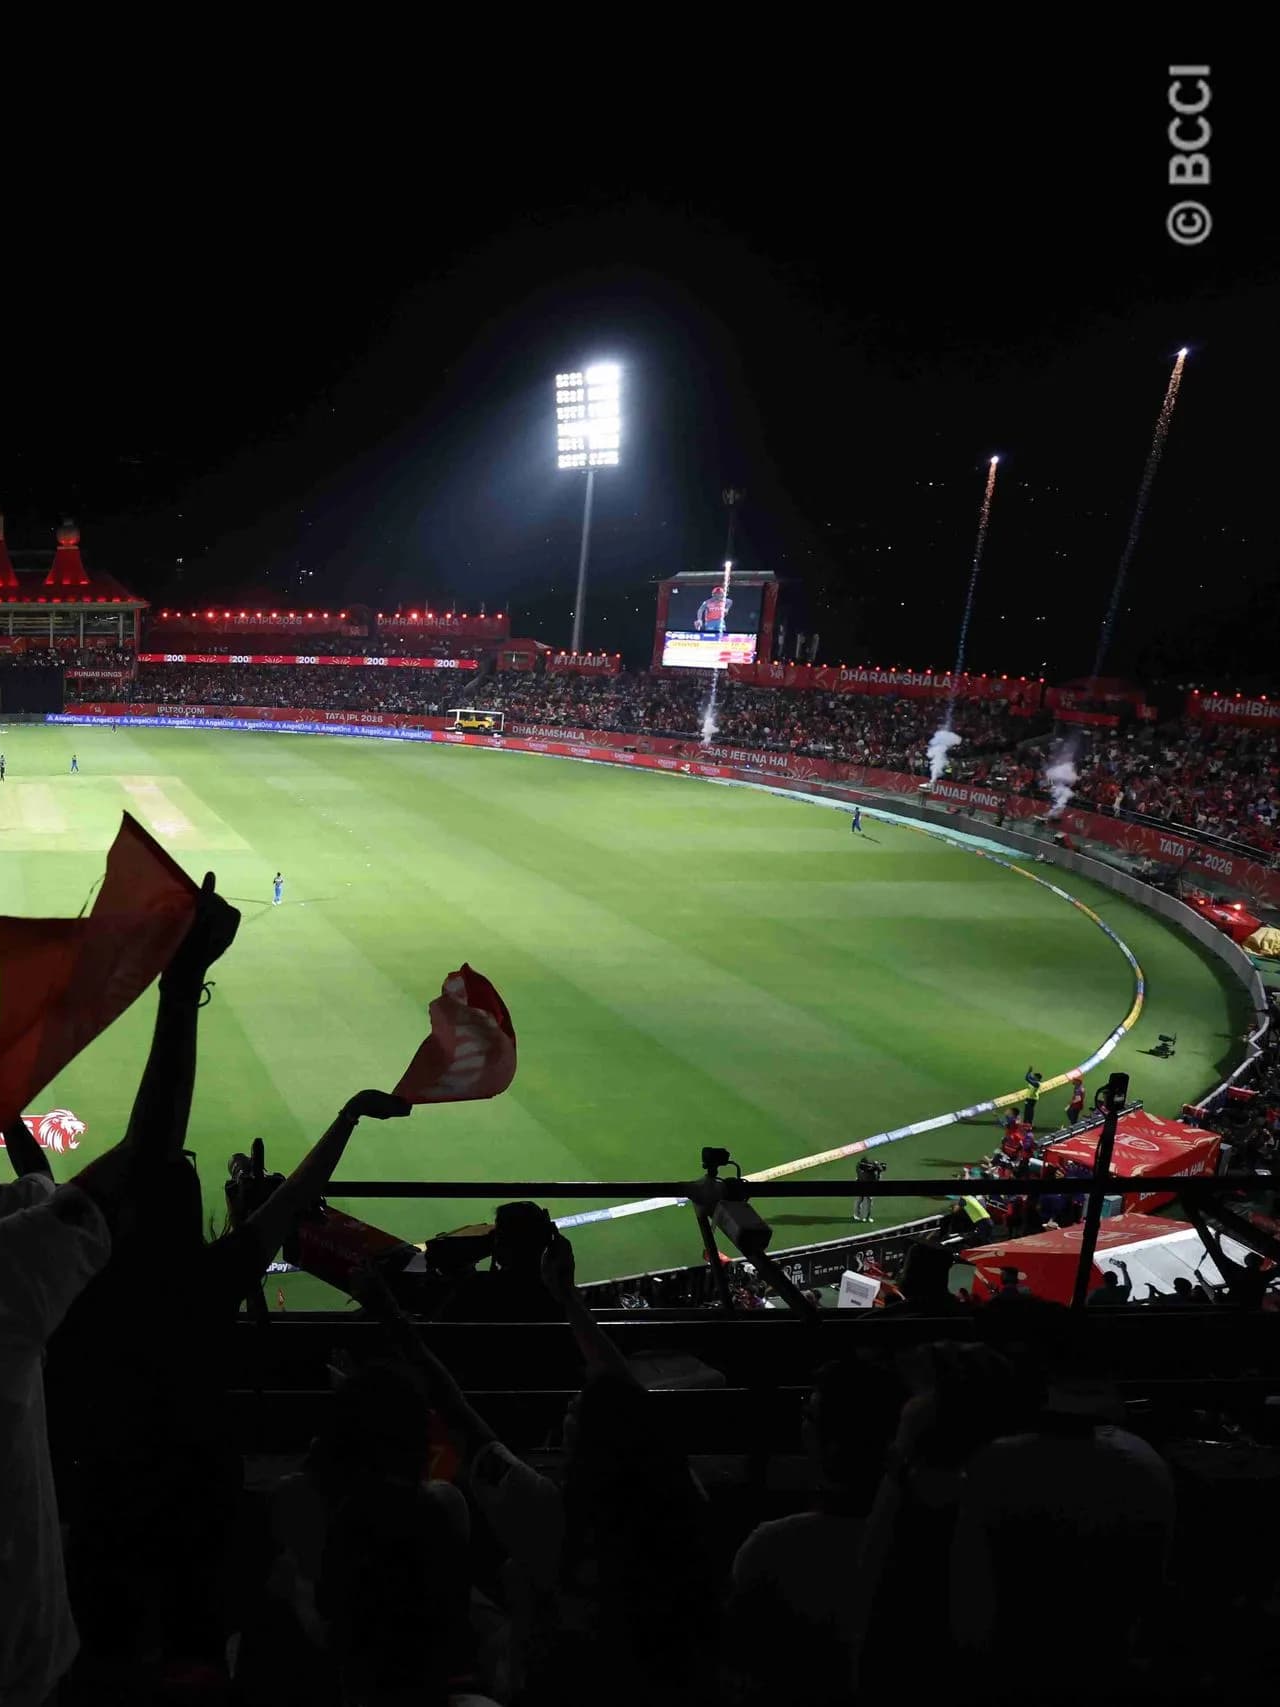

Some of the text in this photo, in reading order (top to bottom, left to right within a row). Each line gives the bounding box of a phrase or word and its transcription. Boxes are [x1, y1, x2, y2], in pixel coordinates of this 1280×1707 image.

[232, 655, 248, 663] 200
[299, 656, 316, 664] 200
[367, 657, 384, 665] 200
[554, 655, 611, 667] #TATAIPL
[130, 717, 158, 725] AngelOne
[206, 719, 234, 727] AngelOne
[244, 721, 273, 729] AngelOne
[282, 722, 312, 731] AngelOne
[321, 724, 351, 733] AngelOne
[361, 727, 391, 736] AngelOne
[400, 731, 431, 739] AngelOne
[512, 726, 585, 739] DHARAMSHALA
[730, 749, 767, 764] JEETNA
[770, 754, 788, 766] HAI
[1159, 838, 1185, 857] TATA
[1204, 854, 1233, 876] 2026
[791, 1273, 806, 1284] IPL
